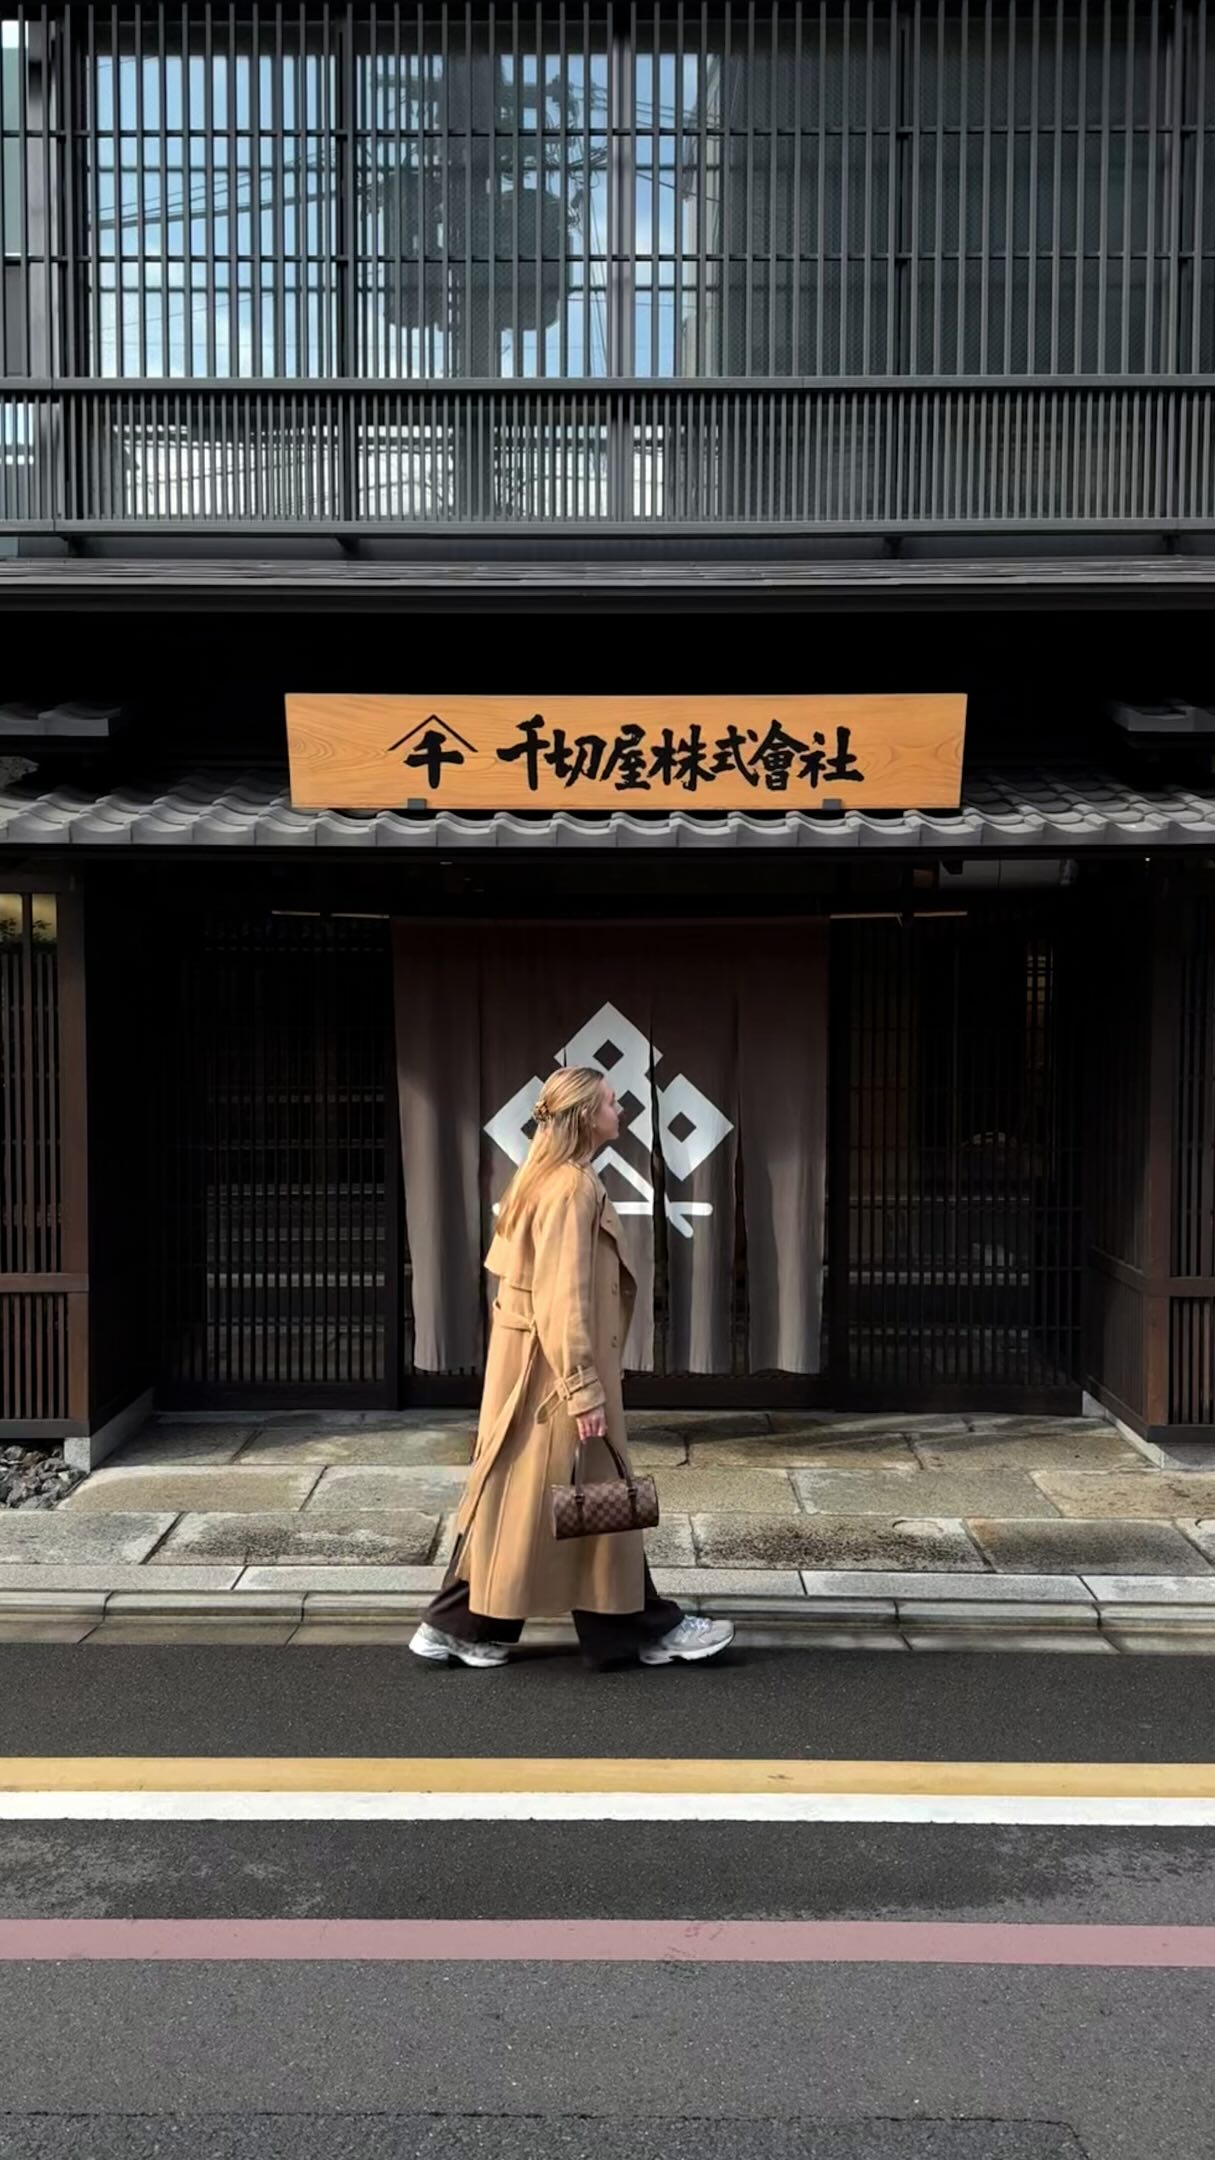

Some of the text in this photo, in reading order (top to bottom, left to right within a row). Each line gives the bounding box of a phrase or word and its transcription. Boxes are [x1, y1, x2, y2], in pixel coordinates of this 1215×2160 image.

[496, 714, 865, 792] 千切屋株式會社
